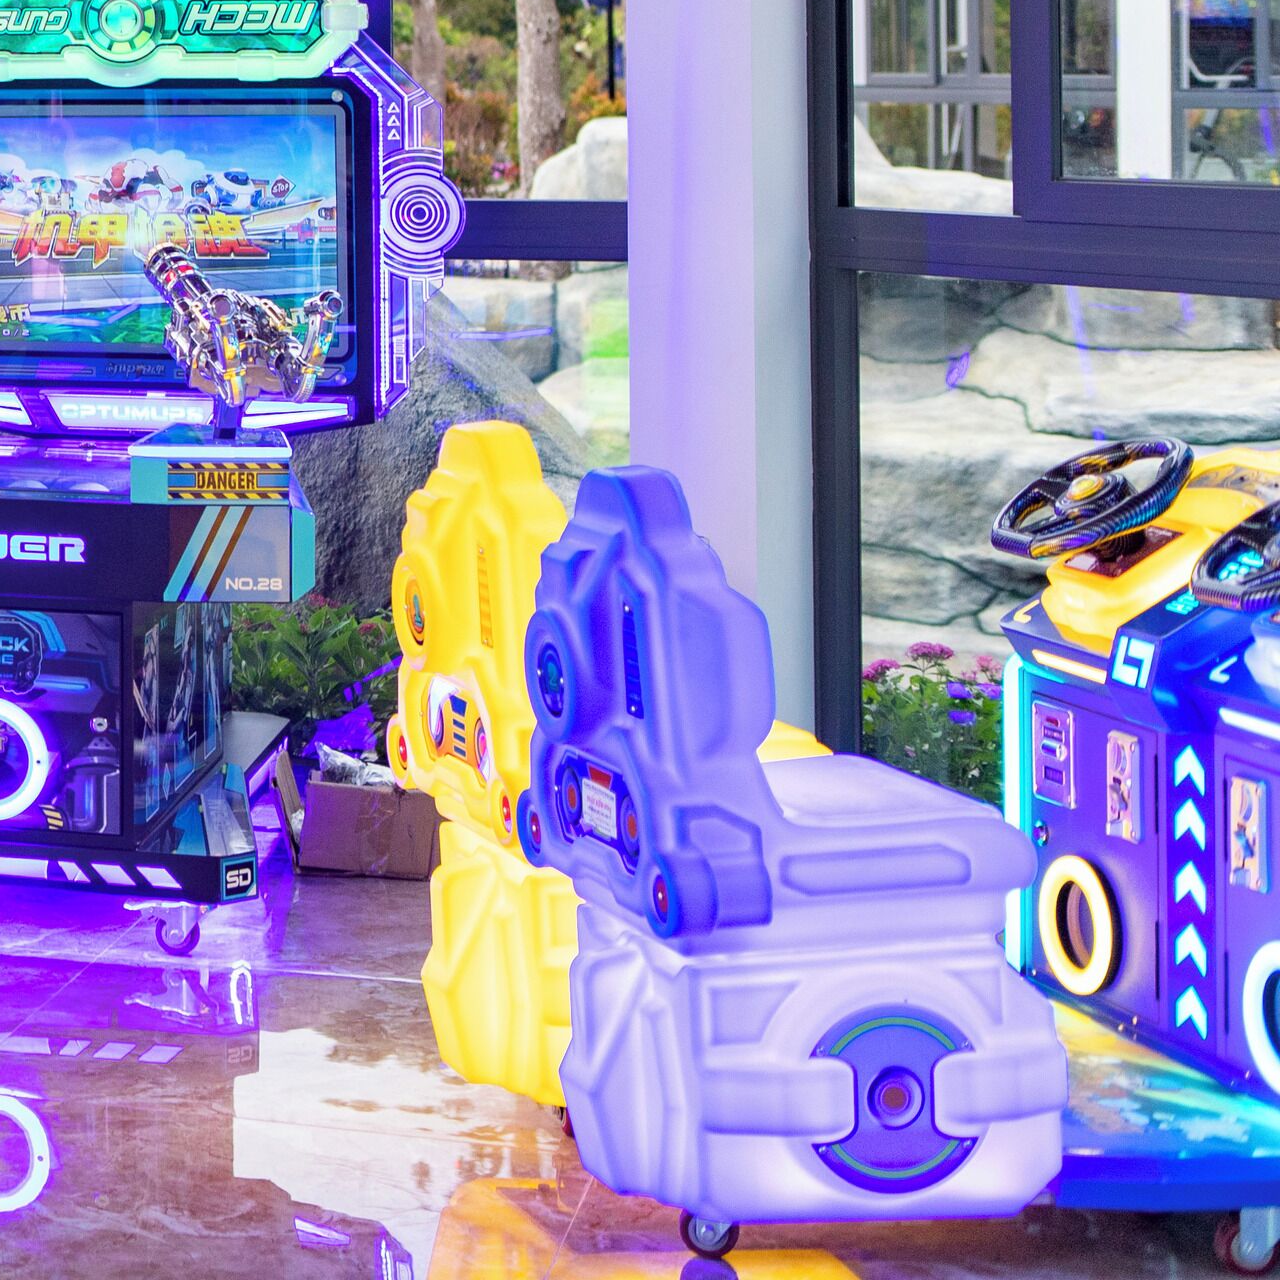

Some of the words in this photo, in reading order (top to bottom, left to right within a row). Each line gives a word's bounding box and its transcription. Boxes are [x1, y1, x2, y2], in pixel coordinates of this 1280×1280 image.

[182, 0, 317, 33] MECH
[272, 183, 289, 193] STOP
[197, 471, 256, 490] DANGER
[225, 576, 283, 591] NO.28
[226, 867, 252, 889] SD
